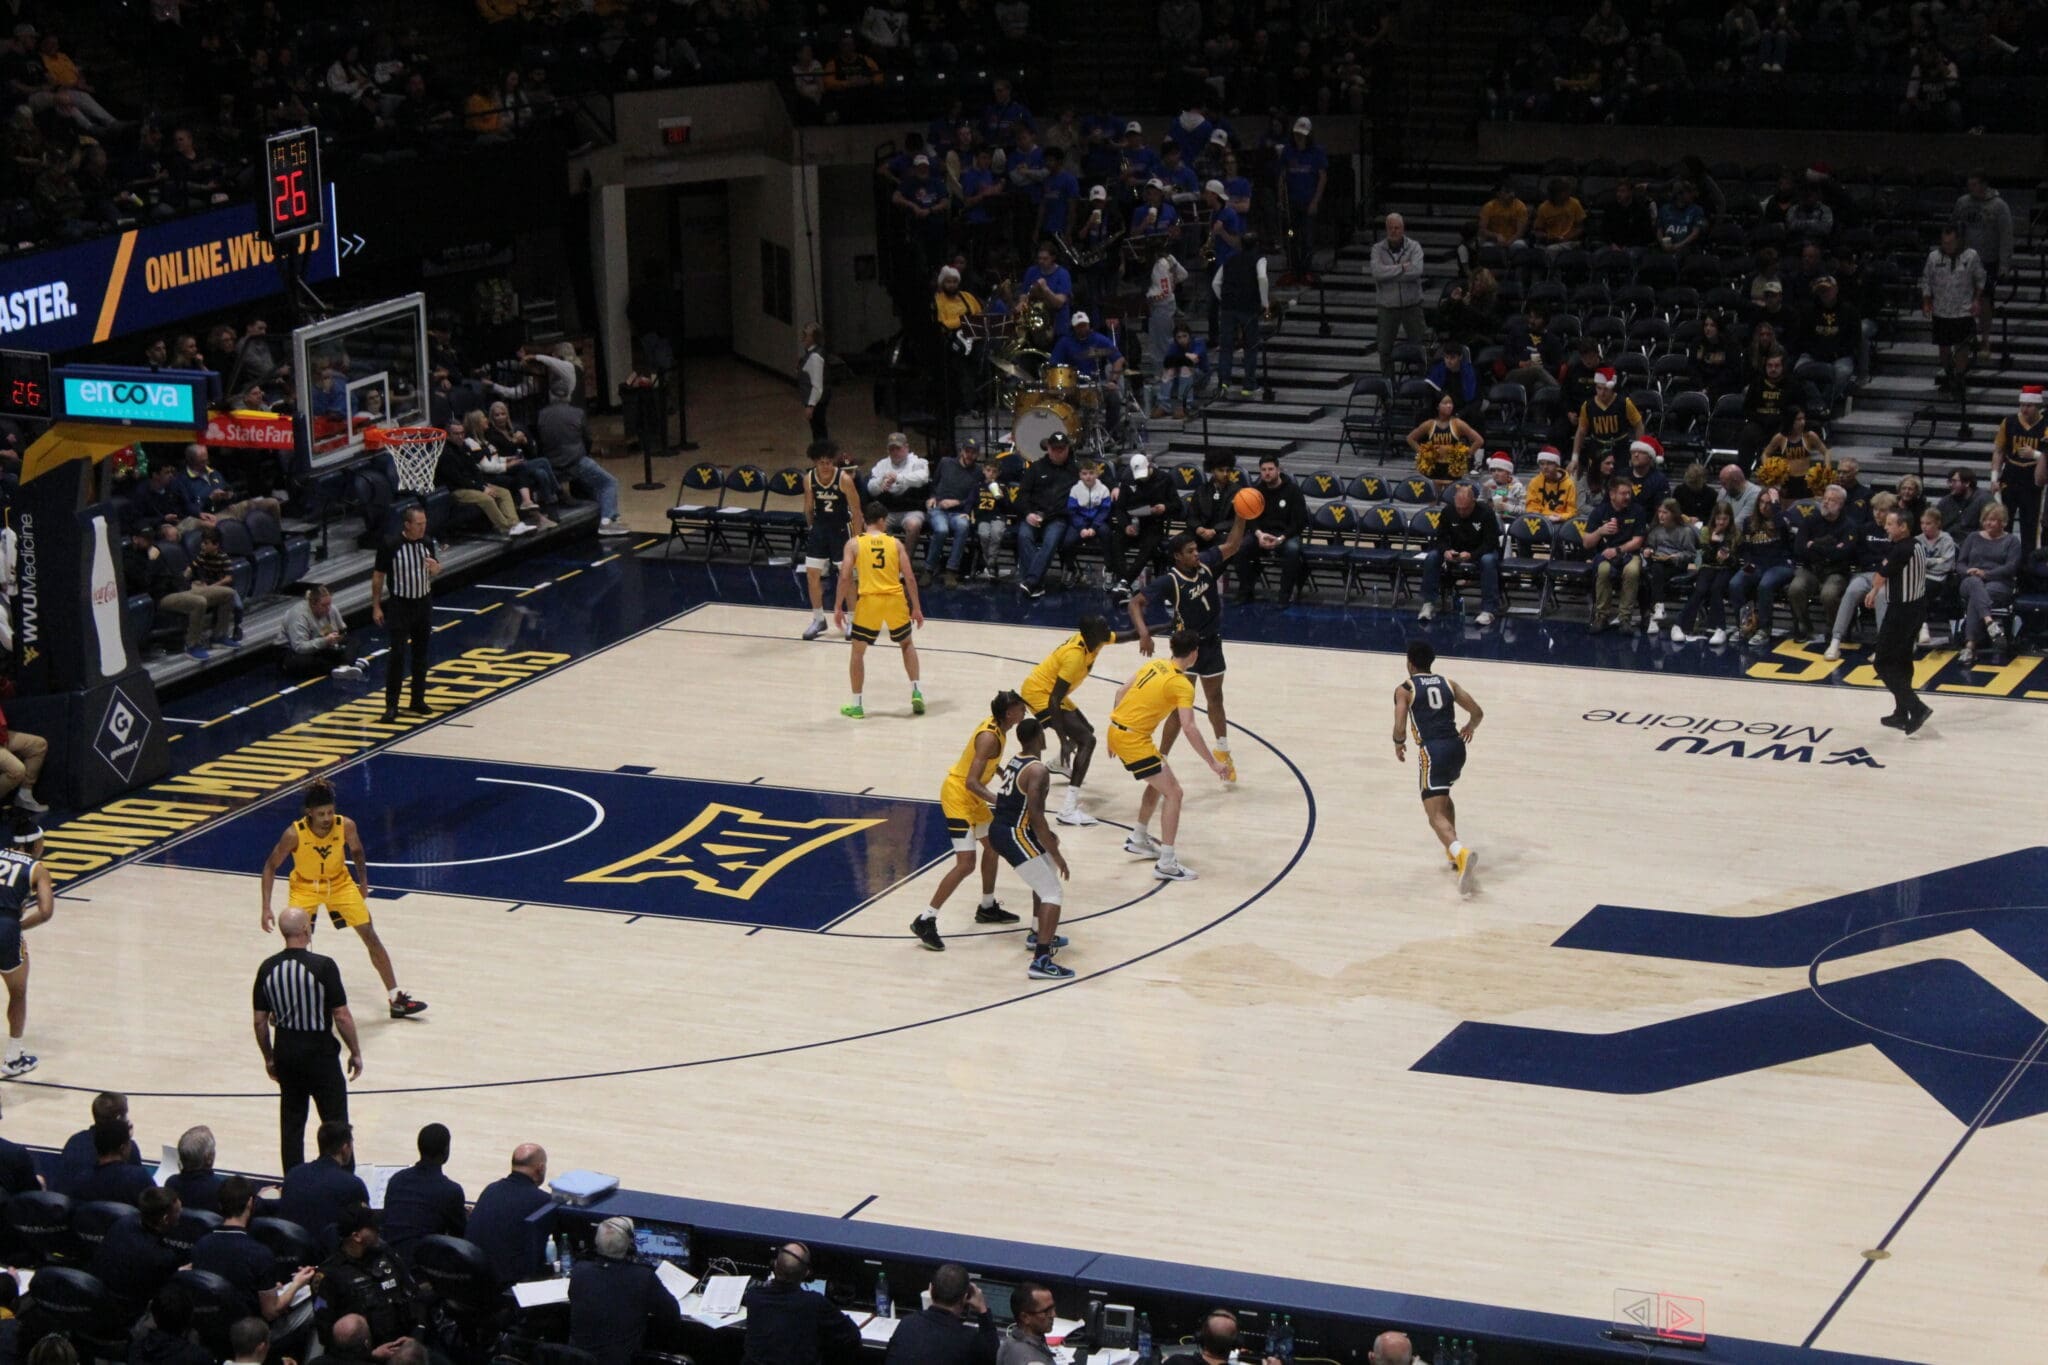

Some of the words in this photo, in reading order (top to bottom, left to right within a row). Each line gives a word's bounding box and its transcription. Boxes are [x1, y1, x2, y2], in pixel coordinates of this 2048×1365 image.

[275, 171, 307, 221] 26
[13, 380, 41, 406] 26
[80, 381, 178, 407] encova
[226, 423, 265, 442] State
[1593, 415, 1619, 434] WVU
[824, 500, 834, 512] 2
[979, 498, 996, 510] 23
[871, 548, 885, 569] 3
[1201, 594, 1211, 611] 1
[1138, 668, 1157, 689] 11
[1427, 686, 1443, 710] 0
[1582, 708, 1834, 743] Medicine
[1655, 736, 1813, 763] WVU
[999, 768, 1016, 797] 23
[0, 859, 22, 887] 21
[320, 862, 325, 875] 1
